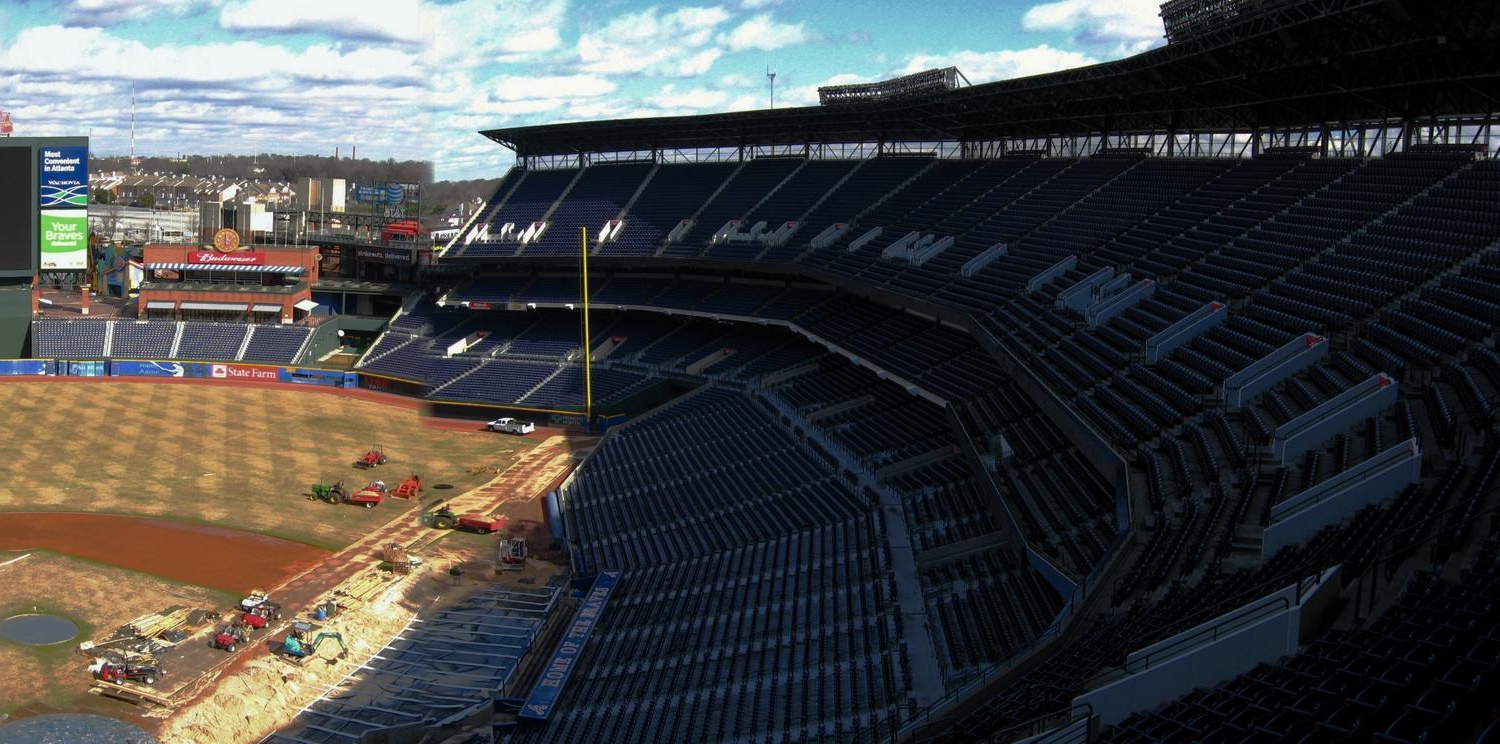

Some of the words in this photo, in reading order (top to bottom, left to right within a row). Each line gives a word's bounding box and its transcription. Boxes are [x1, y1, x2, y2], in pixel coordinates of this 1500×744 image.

[51, 222, 78, 231] Your
[46, 231, 84, 240] Braves
[197, 253, 256, 262] Budweiser
[228, 367, 250, 377] State
[252, 370, 276, 379] Farm
[541, 657, 573, 688] HOME
[568, 619, 593, 639] THE
